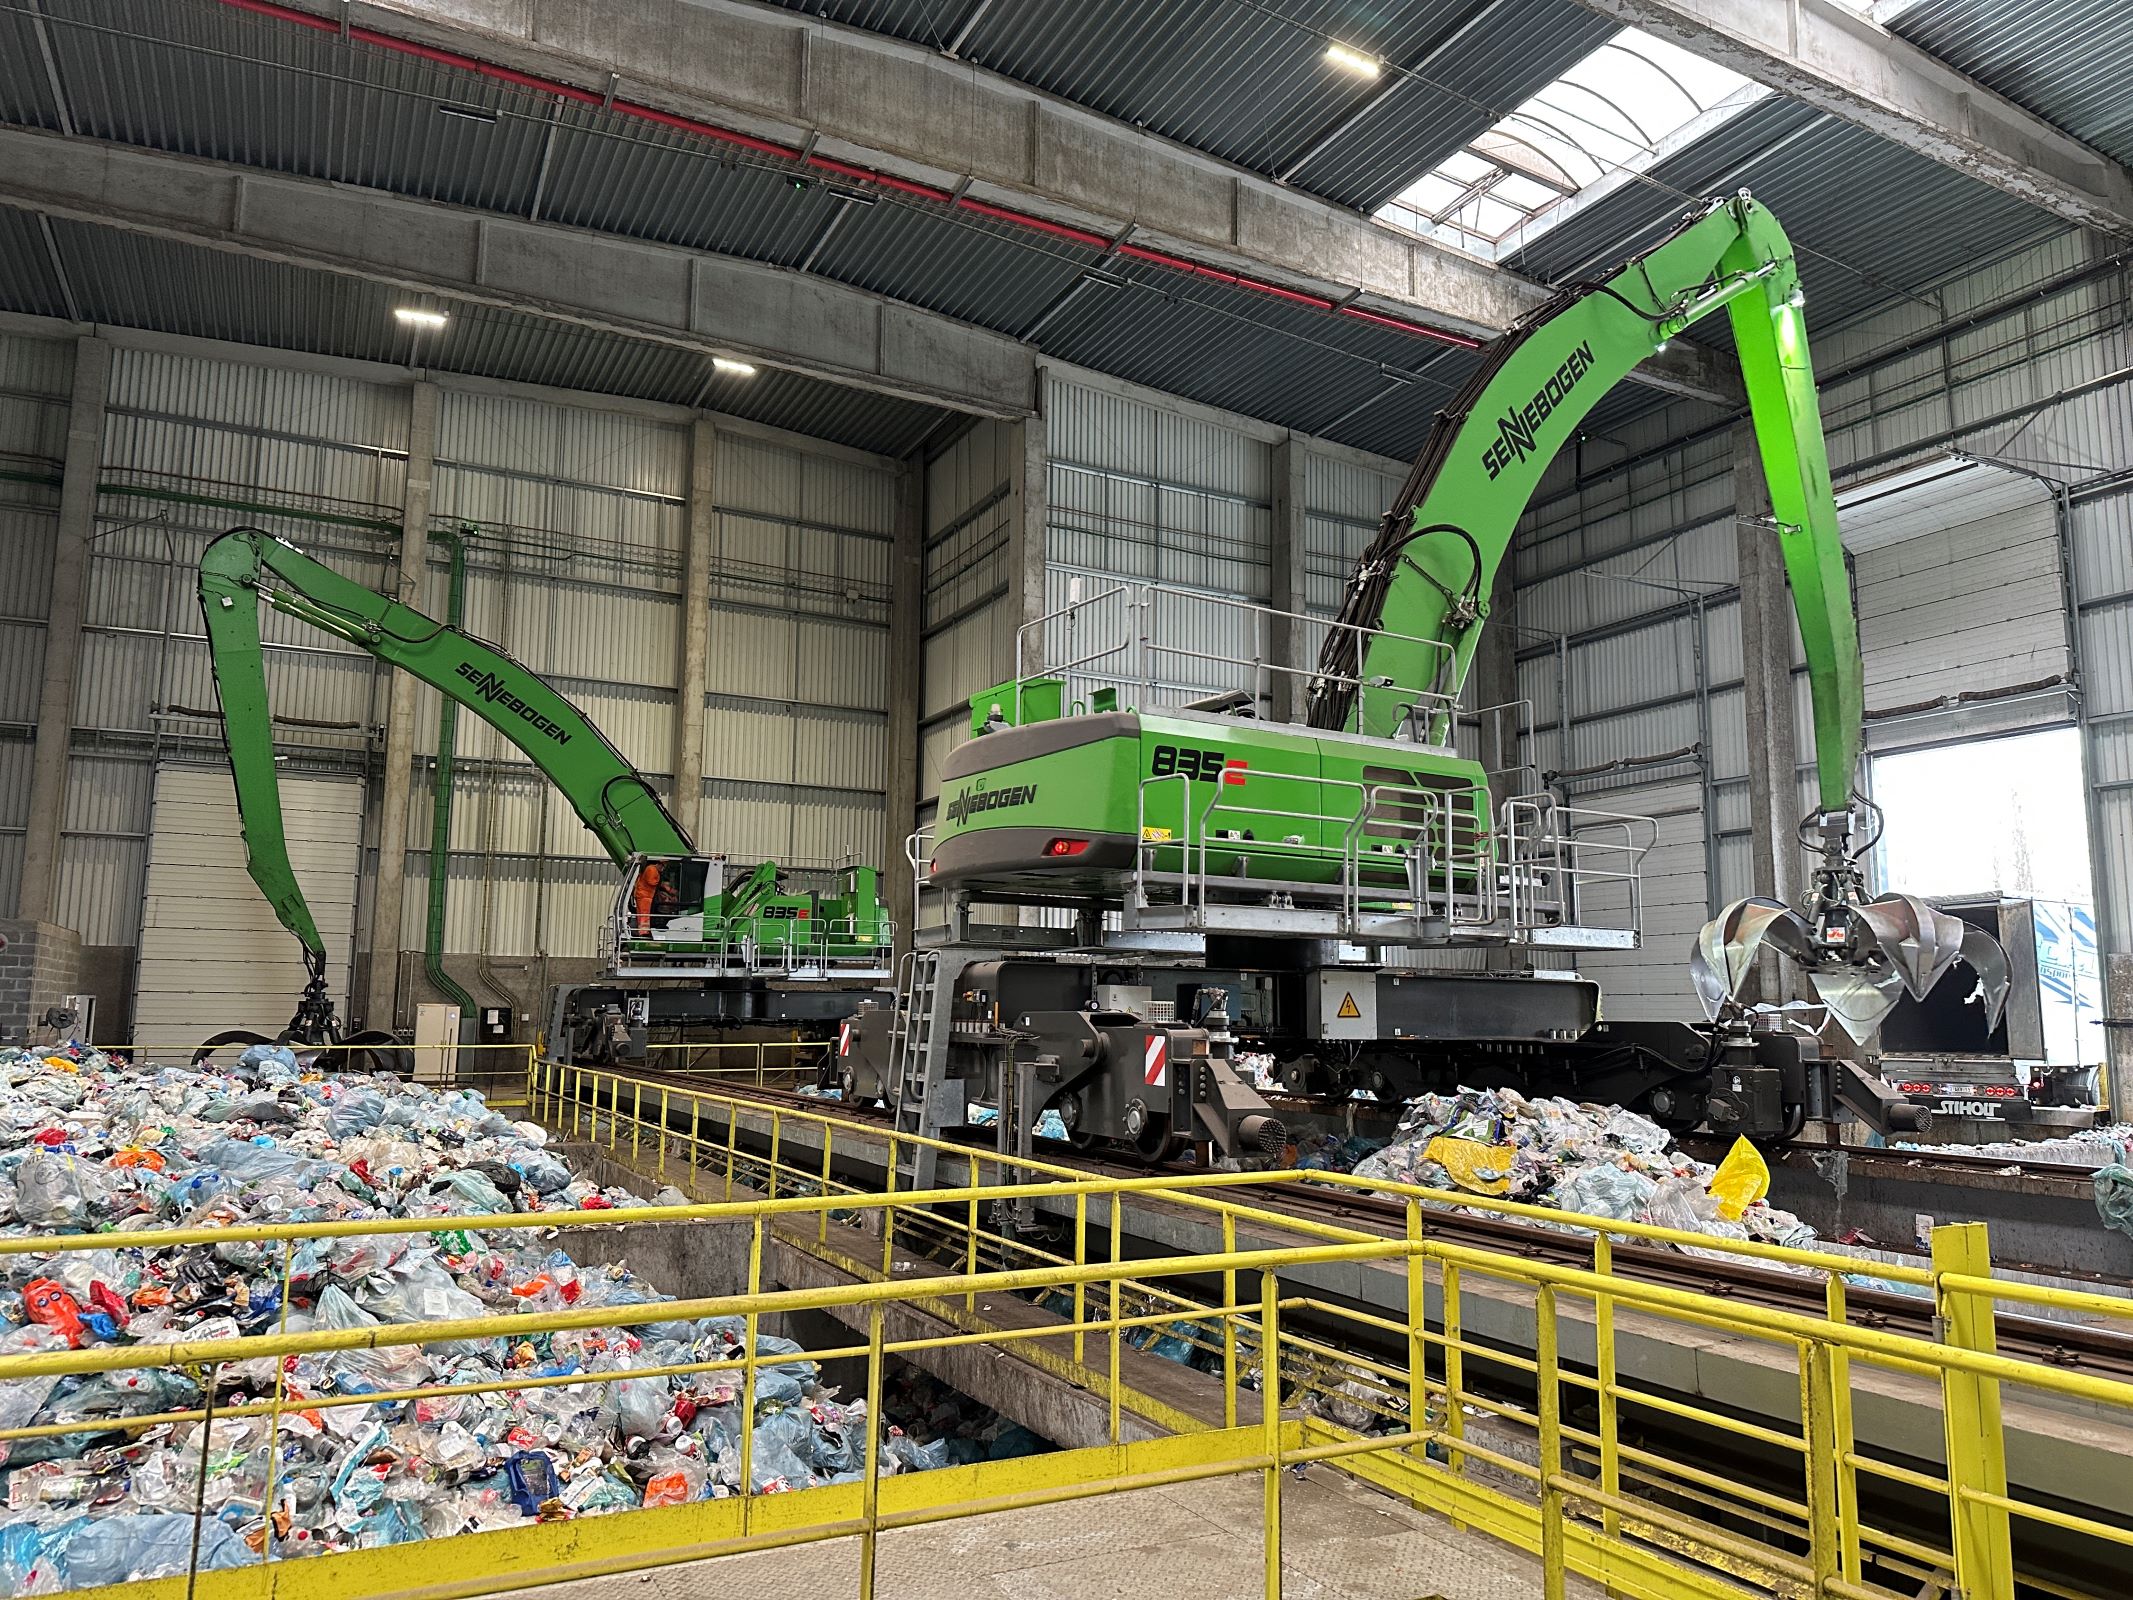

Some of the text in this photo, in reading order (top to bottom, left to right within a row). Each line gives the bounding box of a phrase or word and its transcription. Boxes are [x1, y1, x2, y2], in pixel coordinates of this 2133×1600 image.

[1482, 339, 1595, 481] SENNEBOGEN
[454, 661, 573, 746] SENNEBOGEN
[946, 784, 1038, 827] SENNEBOGEN
